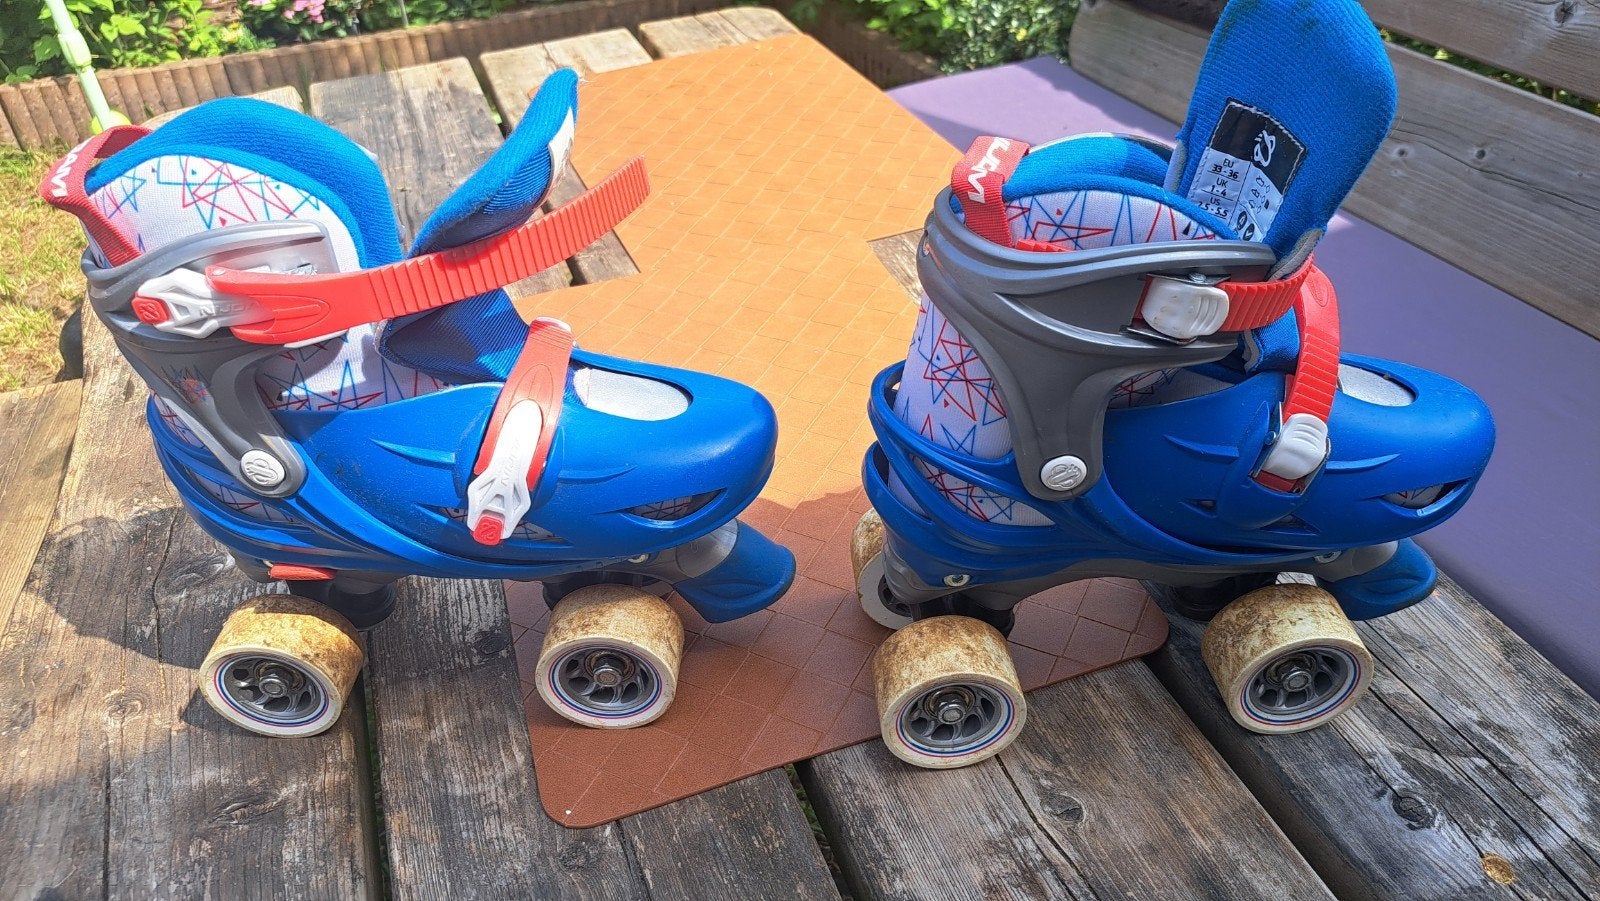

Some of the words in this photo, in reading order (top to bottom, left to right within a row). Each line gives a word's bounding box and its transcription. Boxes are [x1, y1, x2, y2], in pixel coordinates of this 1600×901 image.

[1223, 158, 1234, 168] EU
[1216, 178, 1228, 188] UK
[1210, 196, 1221, 206] US
